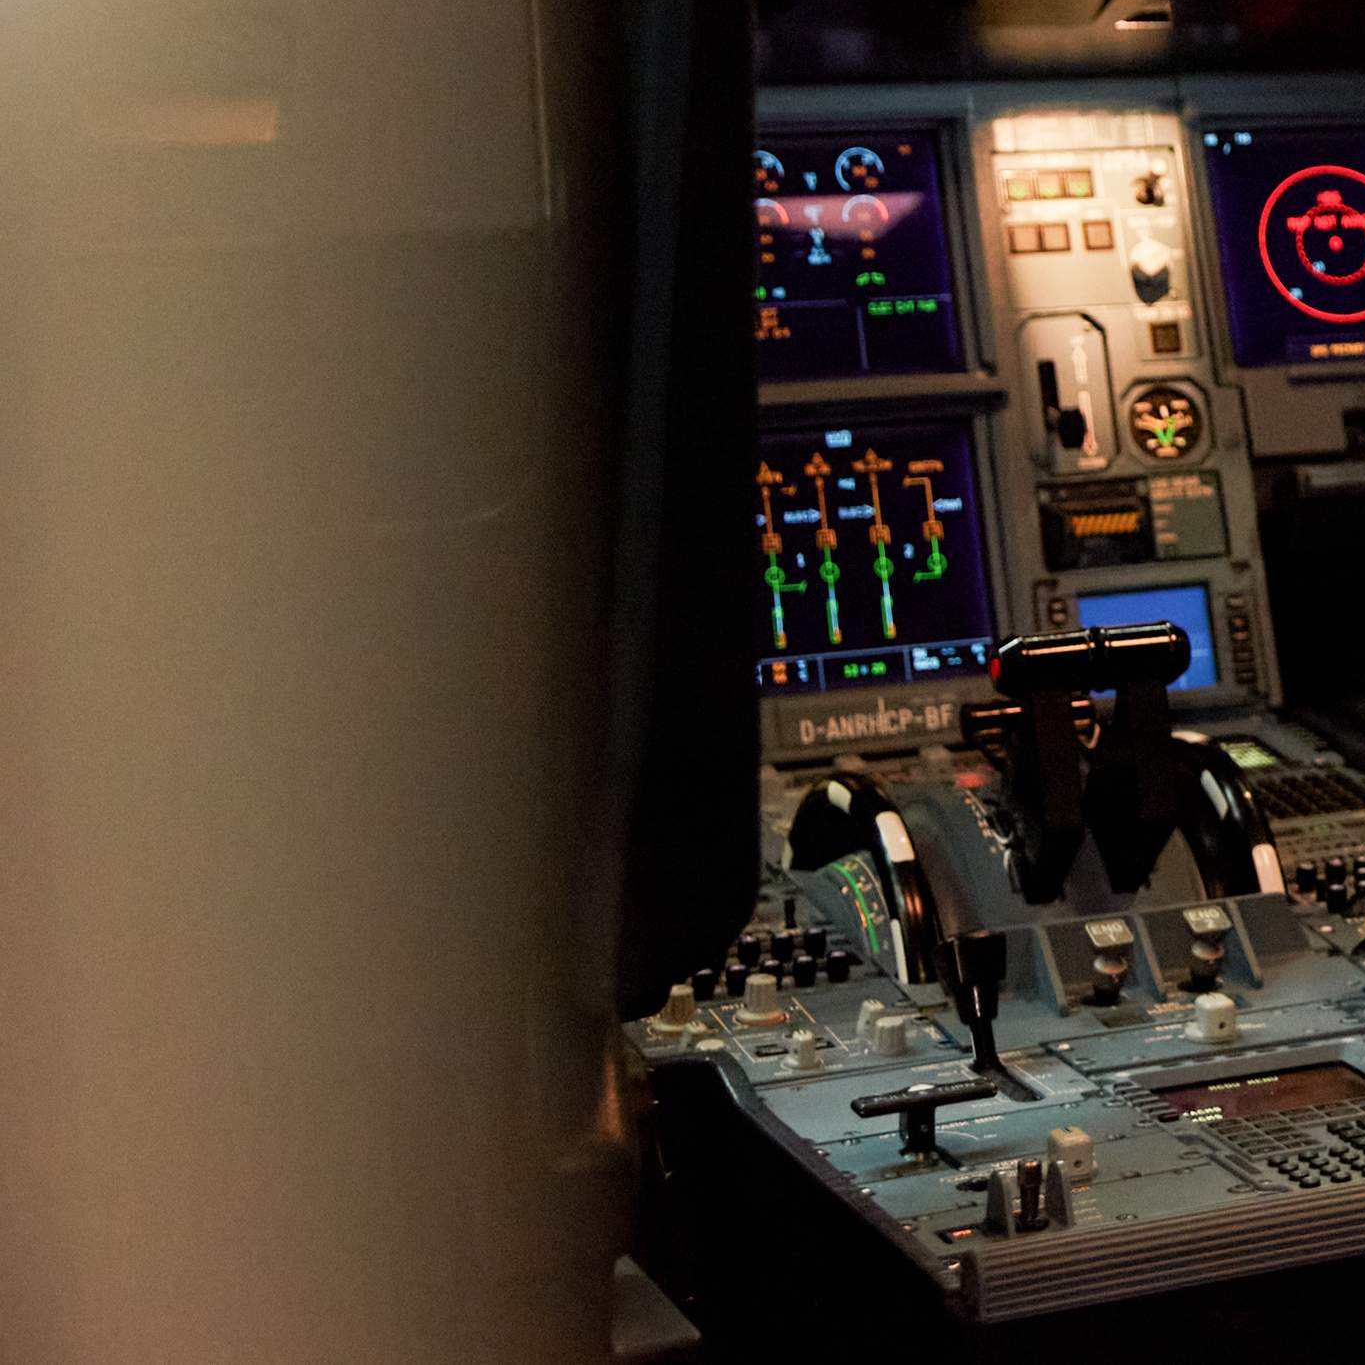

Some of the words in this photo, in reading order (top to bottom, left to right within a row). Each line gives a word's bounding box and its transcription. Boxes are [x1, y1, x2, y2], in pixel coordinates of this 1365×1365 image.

[1190, 907, 1222, 922] ENG
[1090, 922, 1123, 937] ENG
[1246, 1076, 1280, 1086] MENU
